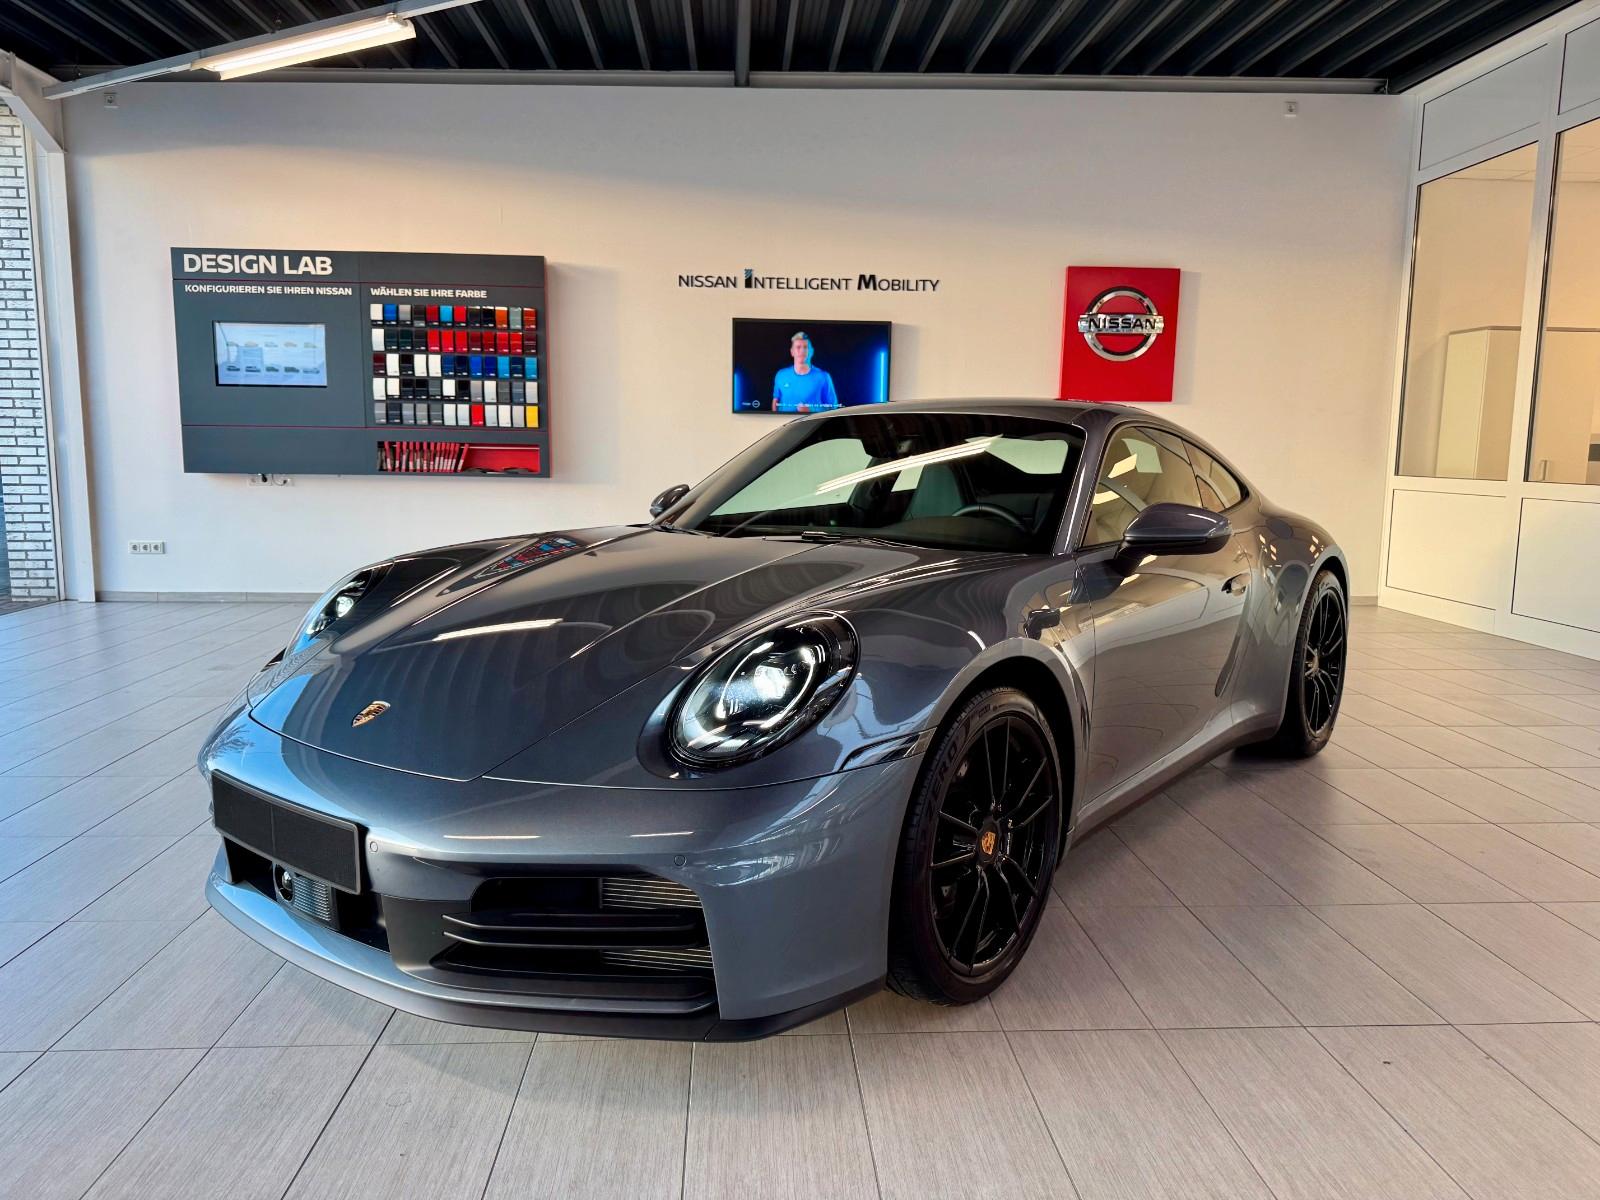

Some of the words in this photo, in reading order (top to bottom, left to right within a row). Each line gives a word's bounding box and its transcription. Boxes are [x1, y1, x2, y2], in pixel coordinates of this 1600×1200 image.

[183, 253, 277, 274] DESIGN
[283, 255, 333, 275] LAB
[678, 274, 737, 288] NISSAN
[744, 268, 852, 290] INTELLIGENT
[857, 274, 939, 292] MOBILITY
[184, 284, 266, 294] KONFIGURIEREN
[267, 286, 283, 295] SIE
[284, 286, 315, 295] IHREN
[316, 287, 352, 296] NISSAN
[370, 286, 412, 297] WÄHLEN
[414, 288, 429, 297] SIE
[431, 288, 454, 298] IHRE
[455, 289, 488, 299] FARBE
[1088, 317, 1157, 330] NISSAN
